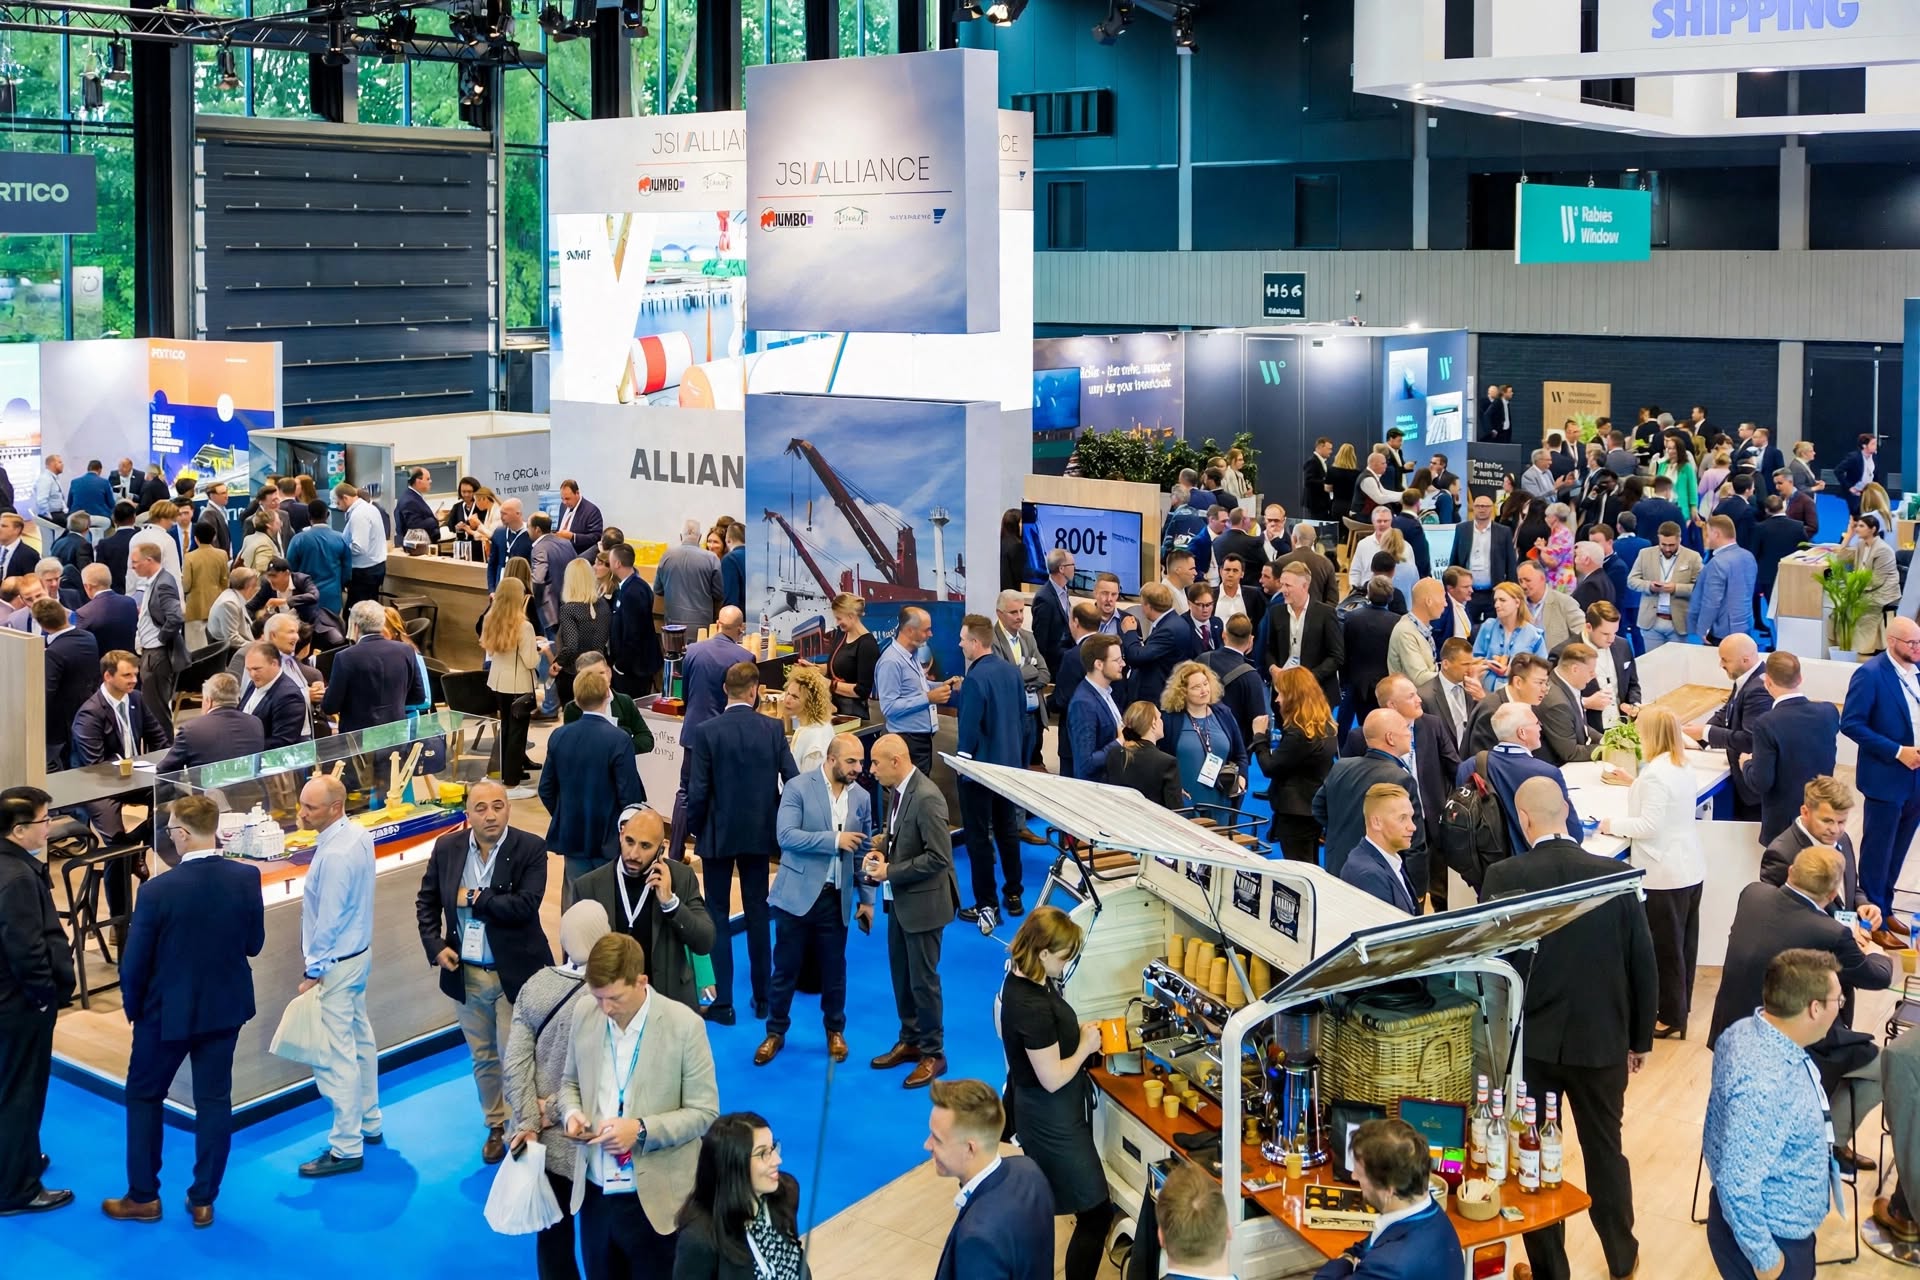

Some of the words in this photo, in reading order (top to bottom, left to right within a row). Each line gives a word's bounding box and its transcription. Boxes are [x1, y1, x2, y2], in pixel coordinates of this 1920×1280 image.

[1651, 0, 1859, 39] SHIPPING
[775, 161, 807, 186] JSI
[630, 448, 745, 489] ALLIAN
[1055, 527, 1108, 556] 800t
